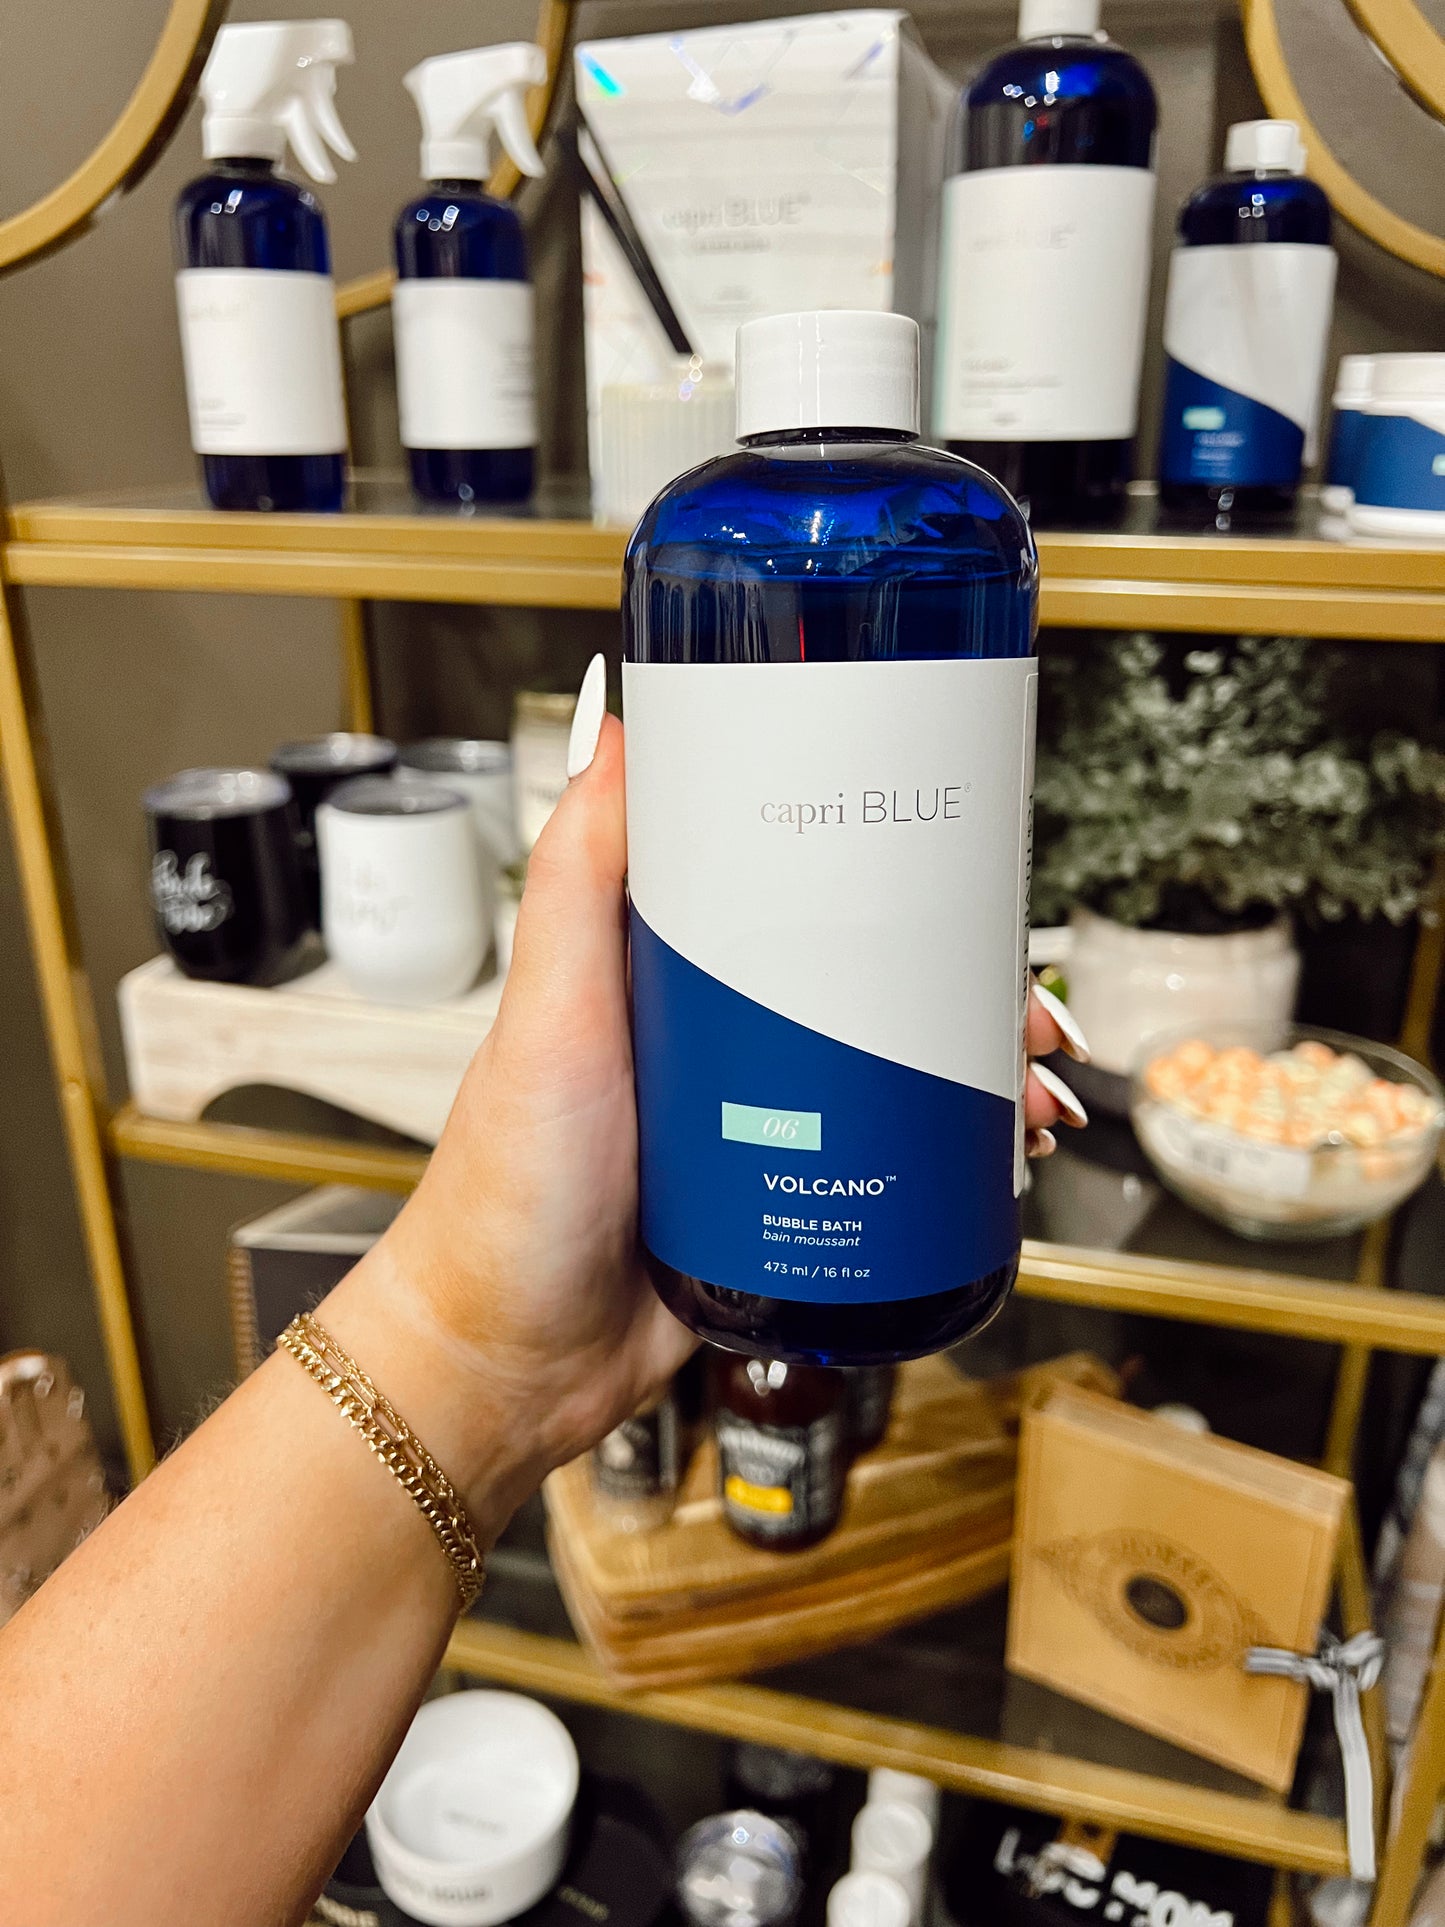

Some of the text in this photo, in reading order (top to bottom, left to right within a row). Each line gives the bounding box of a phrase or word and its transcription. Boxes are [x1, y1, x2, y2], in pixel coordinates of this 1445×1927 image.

[760, 792, 847, 834] capri
[762, 1116, 800, 1140] 06
[763, 1214, 862, 1232] BUBBLE BATH
[762, 1229, 861, 1247] bain moussant
[763, 1261, 871, 1278] 473 ml / 16 fl oz
